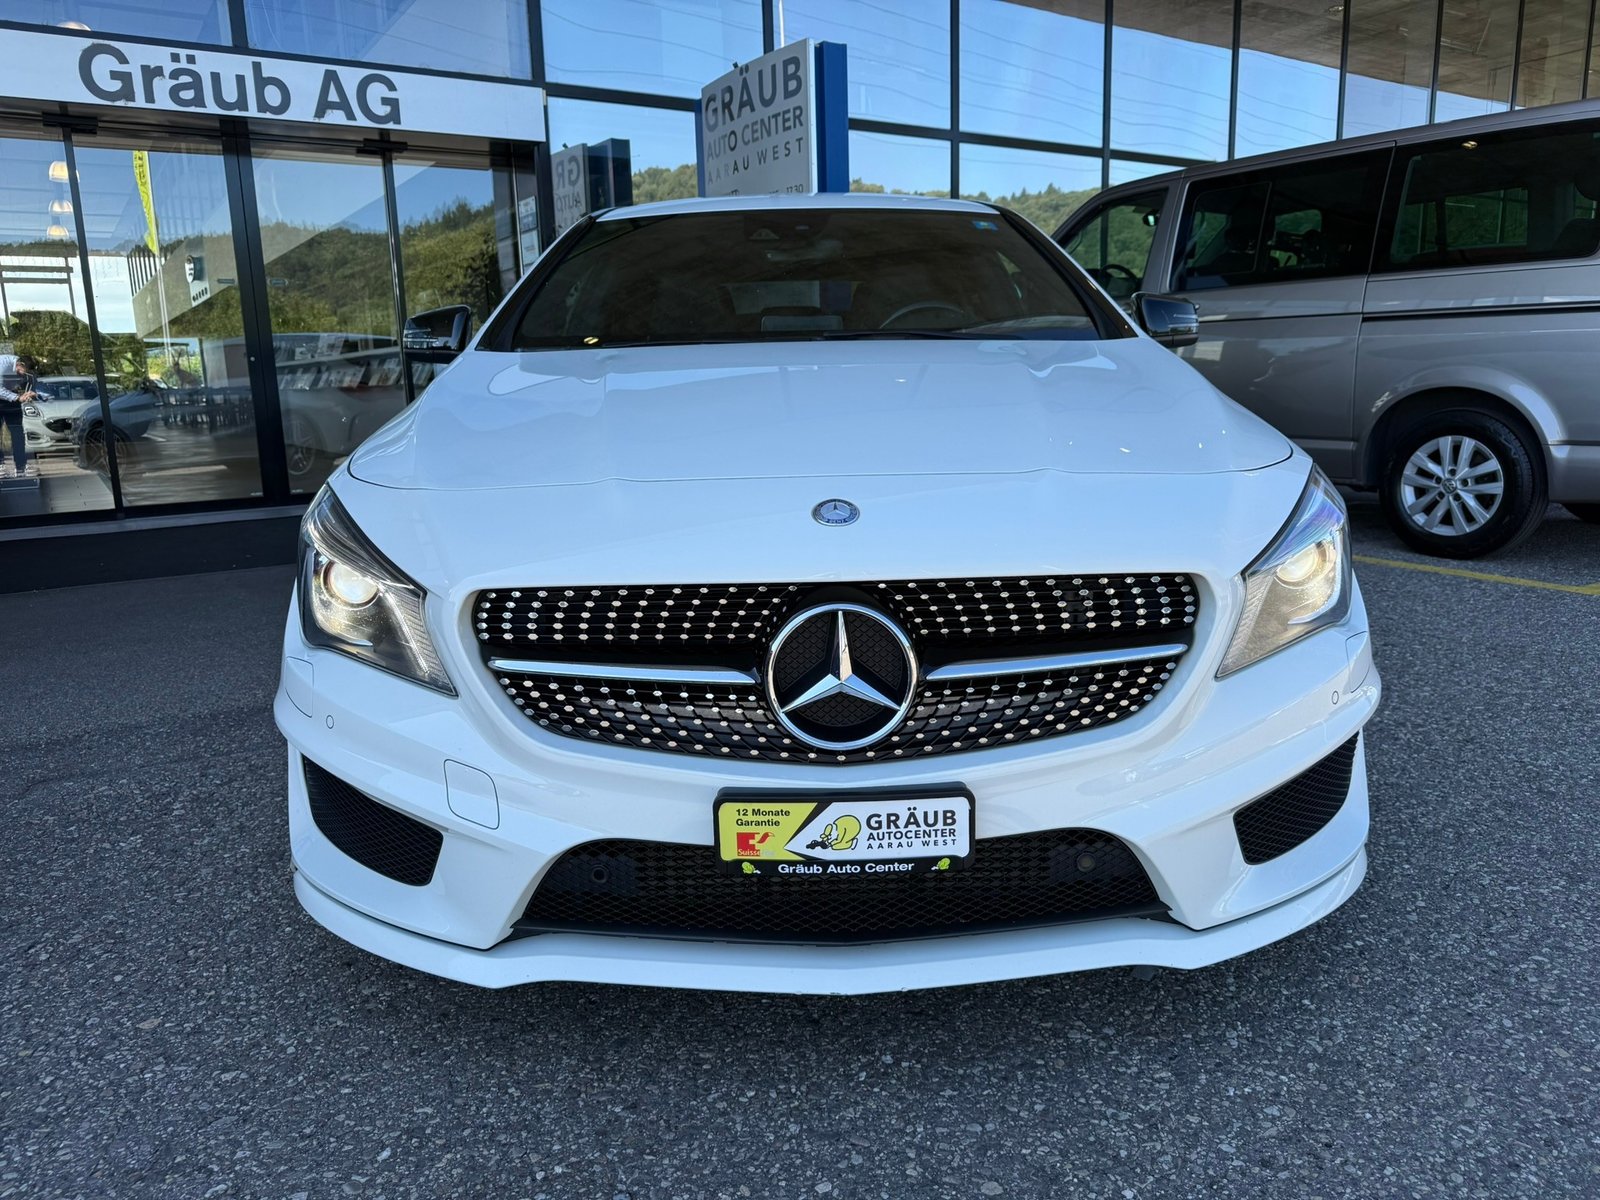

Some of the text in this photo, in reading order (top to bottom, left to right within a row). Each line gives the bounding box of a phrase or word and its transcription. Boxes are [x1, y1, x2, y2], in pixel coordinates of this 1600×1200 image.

[78, 42, 402, 125] Gräub AG
[704, 55, 803, 132] GRÄUB
[706, 105, 804, 162] AUTO CENTER
[707, 137, 804, 185] AARAU WEST
[736, 808, 791, 817] 12 Monate
[865, 806, 957, 831] GRÄUB
[735, 818, 781, 827] Garantie
[866, 828, 957, 842] AUTOCENTER
[866, 839, 957, 850] AARAU WEST
[777, 862, 915, 875] Gräub Auto Center
